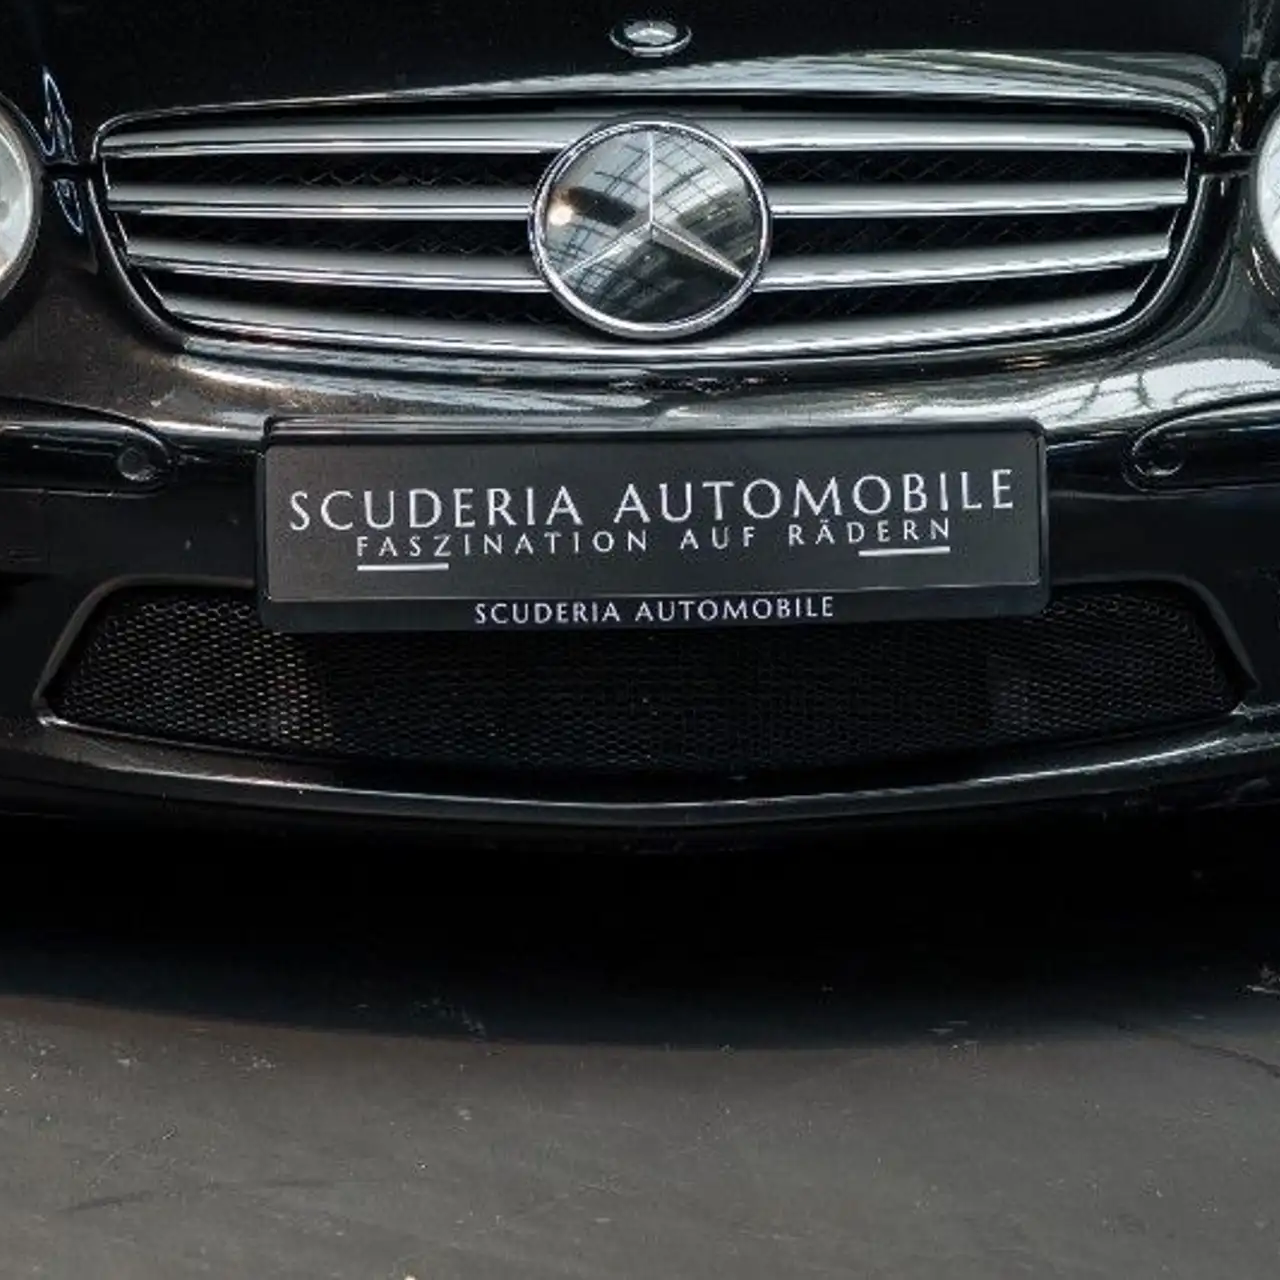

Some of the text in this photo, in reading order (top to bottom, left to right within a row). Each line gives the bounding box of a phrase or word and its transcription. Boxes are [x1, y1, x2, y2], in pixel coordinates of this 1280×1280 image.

[289, 468, 1014, 531] SCUDERIA AUTOMOBILE
[356, 518, 950, 557] FASZINATION AUF RÄDERN
[475, 595, 834, 624] SCUDERIA AUTOMOBILE
